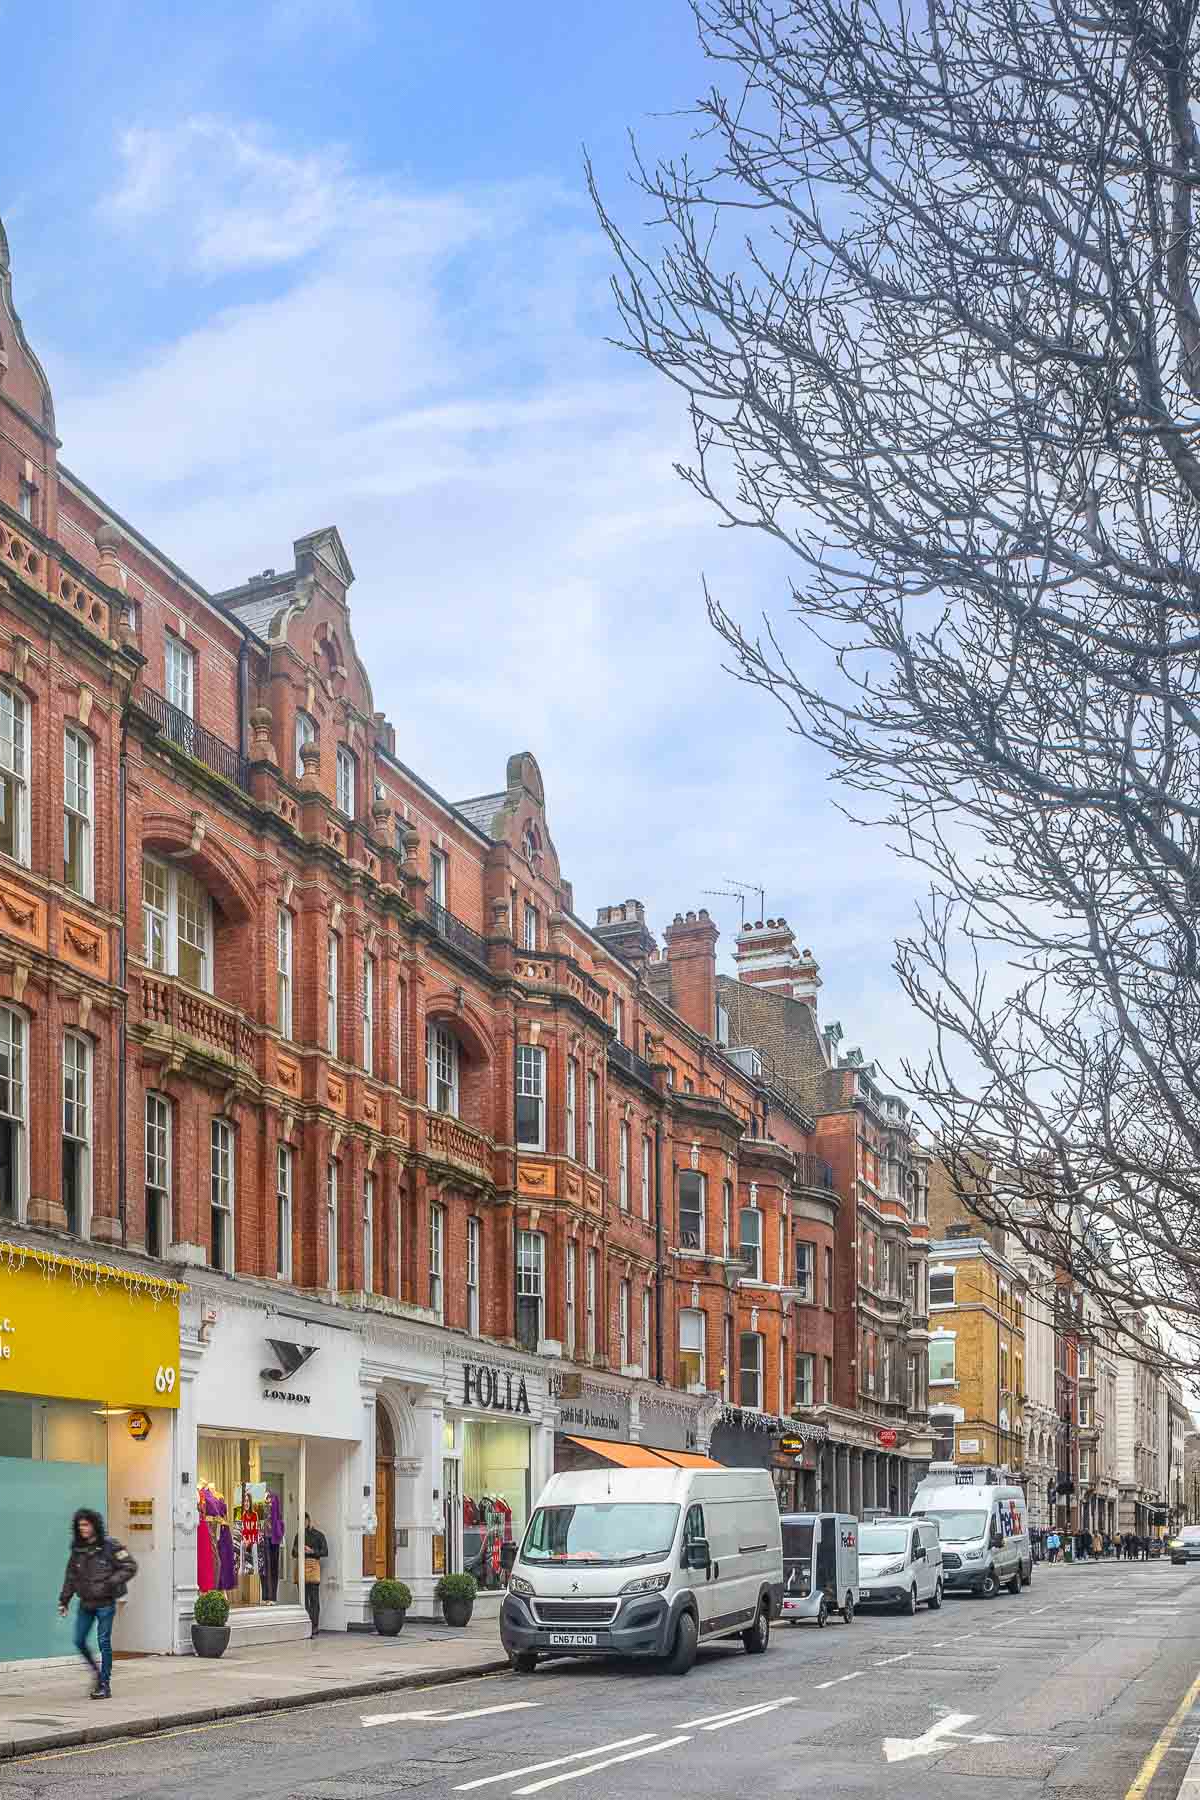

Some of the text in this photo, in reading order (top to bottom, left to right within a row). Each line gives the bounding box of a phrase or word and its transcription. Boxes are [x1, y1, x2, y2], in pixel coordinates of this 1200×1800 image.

[155, 1366, 176, 1393] 69
[462, 1363, 531, 1413] FOLIA
[264, 1389, 311, 1404] LONDON
[553, 1635, 574, 1643] CN67
